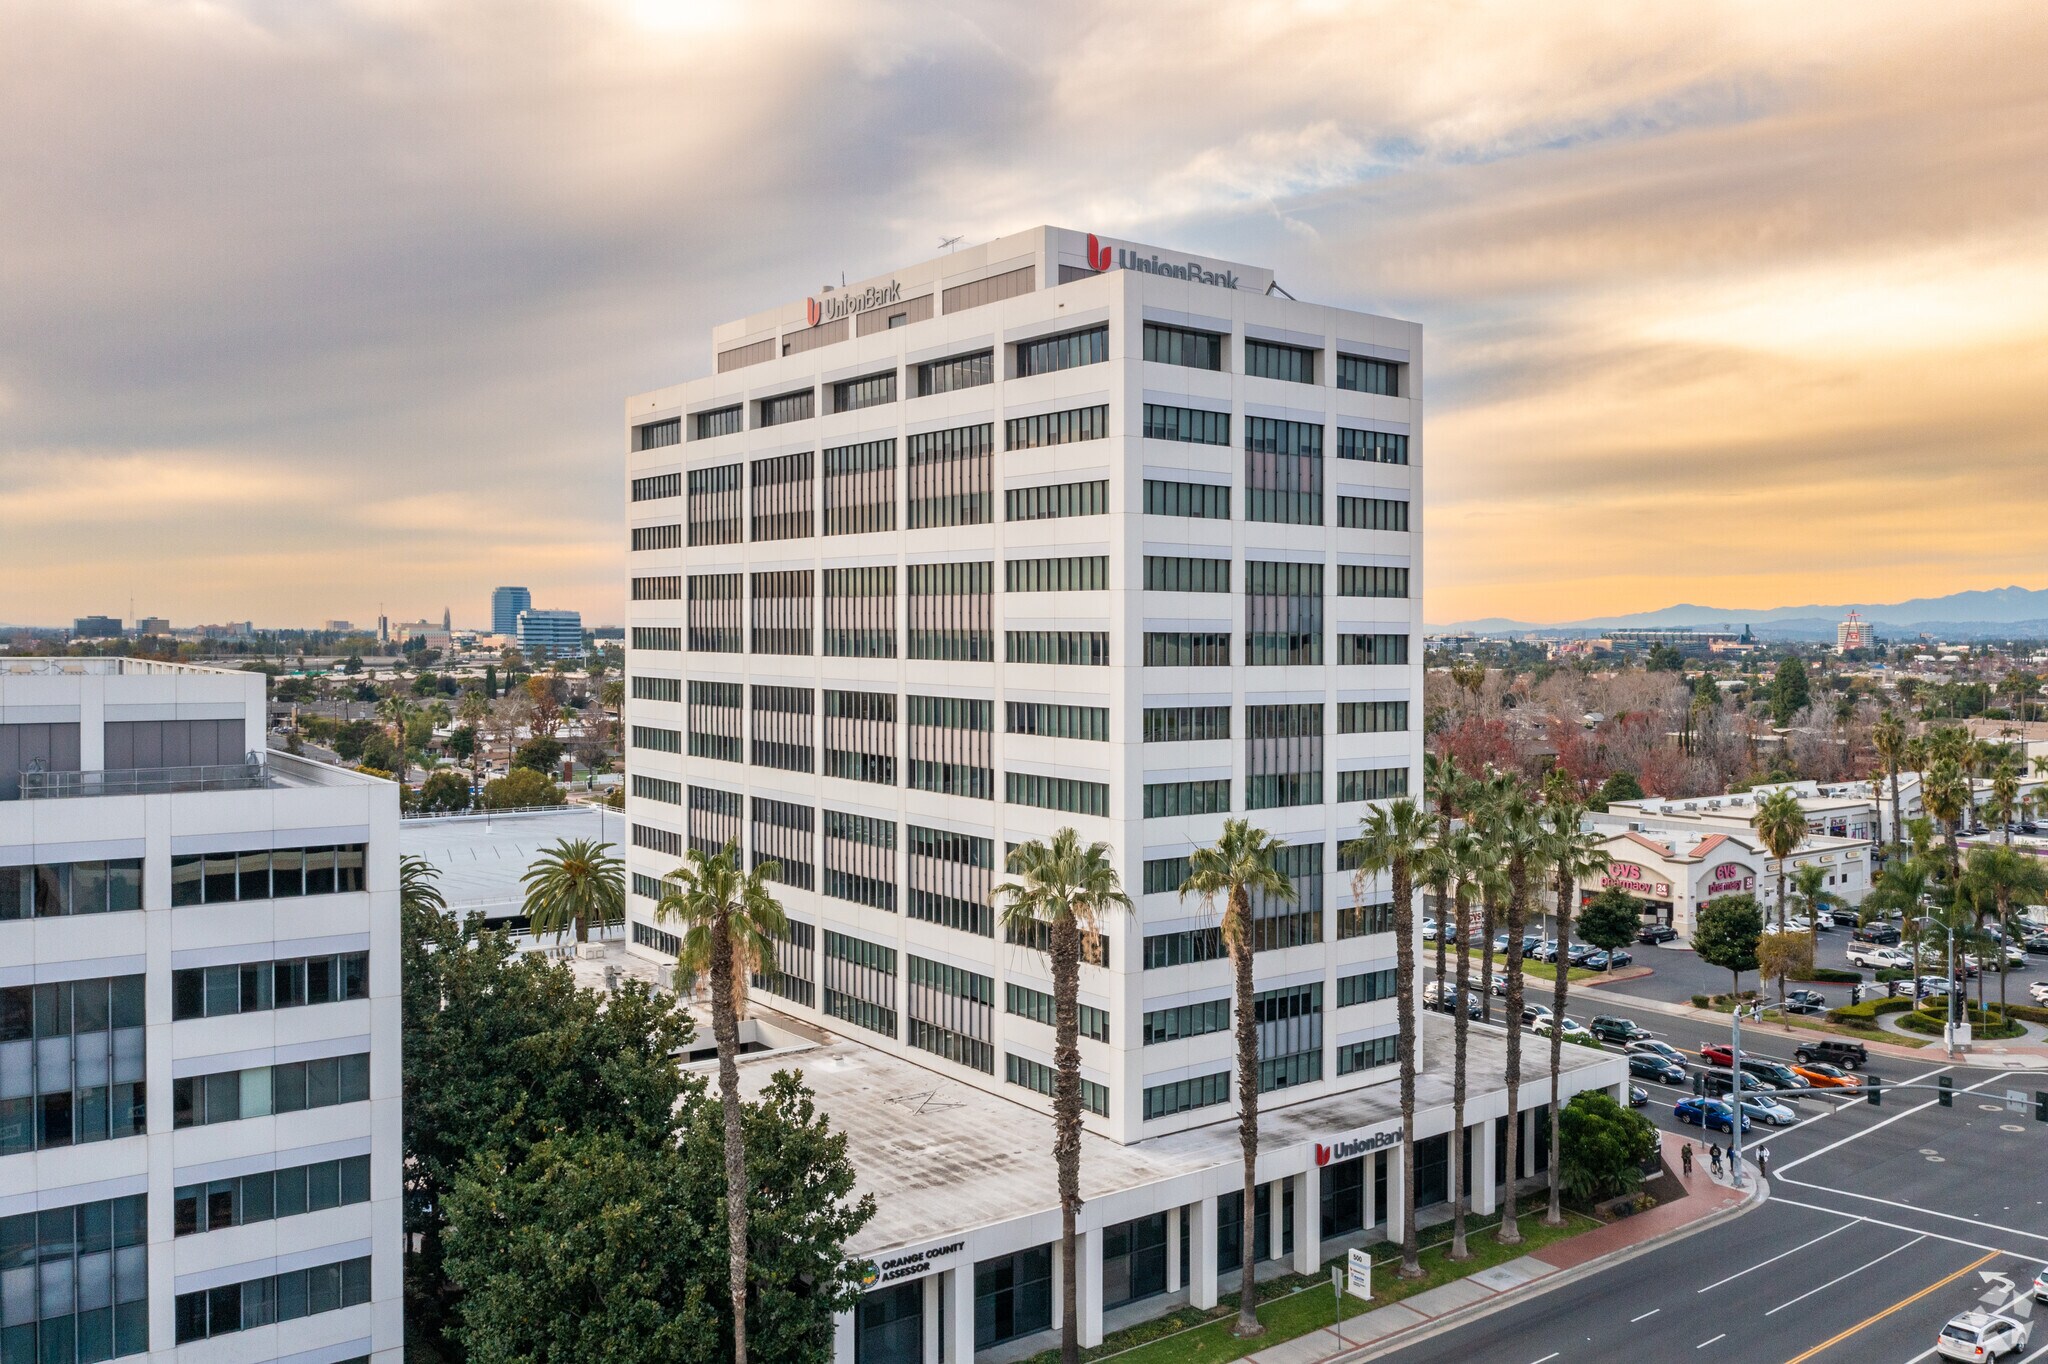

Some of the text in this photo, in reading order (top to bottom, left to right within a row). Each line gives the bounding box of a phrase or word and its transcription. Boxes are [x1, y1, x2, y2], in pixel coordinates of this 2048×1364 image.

[1119, 248, 1239, 290] UnionBank
[825, 279, 901, 320] UnionBank
[1608, 863, 1641, 880] CVS
[1715, 864, 1737, 881] CVS
[1657, 883, 1667, 892] 24
[1333, 1126, 1404, 1160] UnionBank
[881, 1241, 965, 1271] ORANGE COUNTY
[1353, 1253, 1363, 1263] 500
[881, 1262, 931, 1282] ASSESSOR
